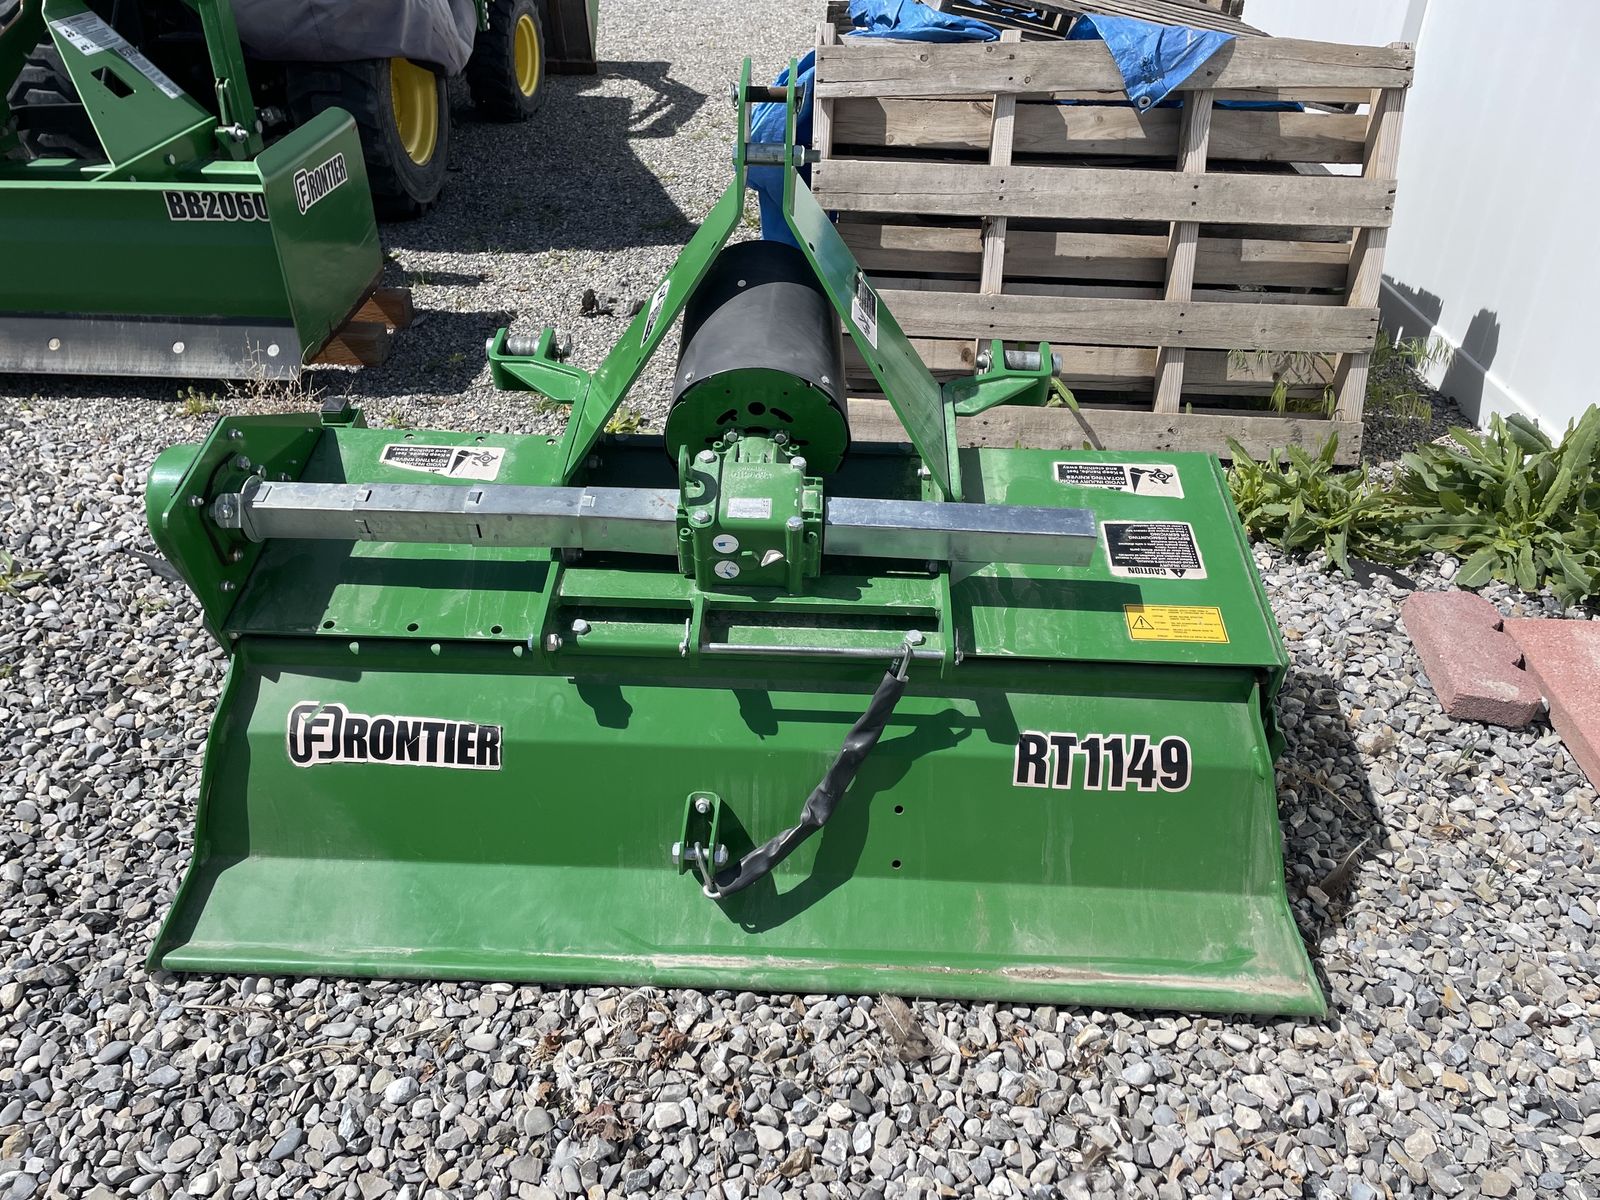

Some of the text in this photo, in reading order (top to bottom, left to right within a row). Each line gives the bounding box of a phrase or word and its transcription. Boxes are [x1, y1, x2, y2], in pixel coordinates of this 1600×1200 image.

[164, 191, 270, 220] BB2060
[294, 153, 348, 214] FRONTIER
[1127, 567, 1167, 576] CAUTION
[289, 704, 501, 767] FRONTIER
[1016, 733, 1189, 789] RT1149
